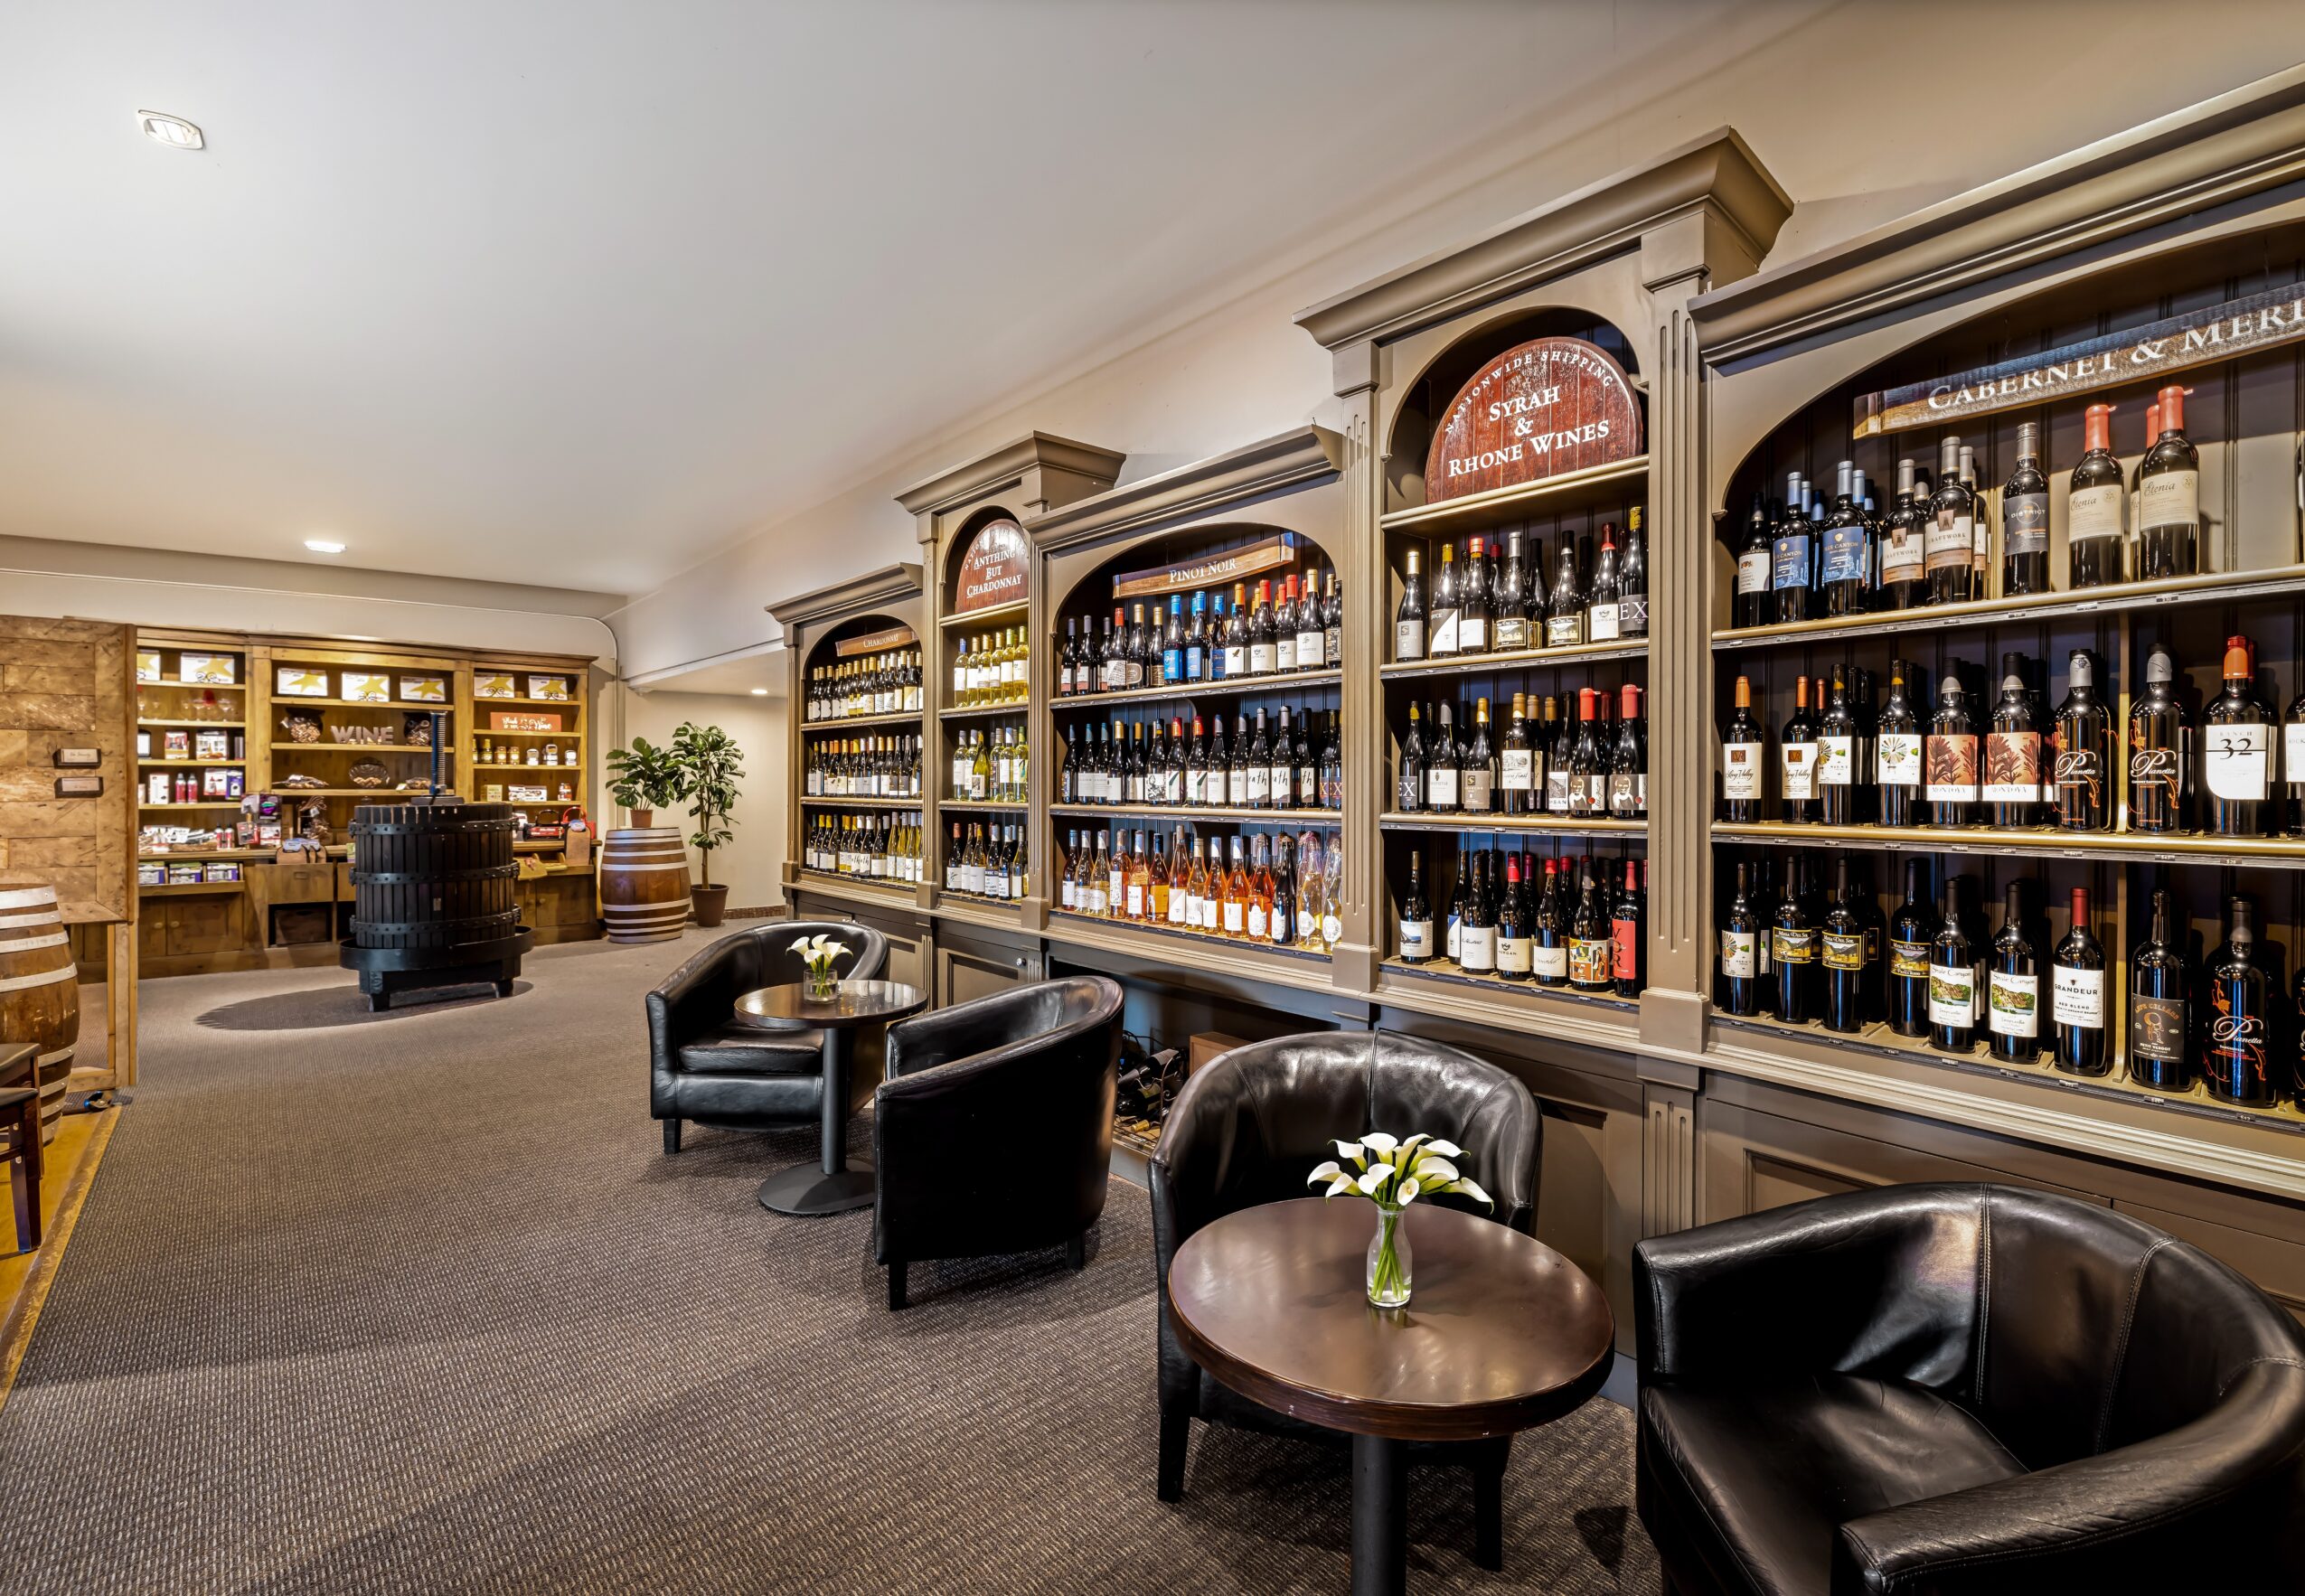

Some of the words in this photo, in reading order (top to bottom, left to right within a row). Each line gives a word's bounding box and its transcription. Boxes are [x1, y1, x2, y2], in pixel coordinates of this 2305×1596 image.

[1927, 349, 2119, 409] CABERNET
[2131, 336, 2169, 364] &
[1445, 353, 1532, 435] NATIONWIDE
[1541, 351, 1614, 387] SHIPPING
[1489, 385, 1560, 422] SYRAH
[1514, 418, 1534, 437] &
[1448, 444, 1523, 477] RHONE
[1530, 419, 1609, 455] WINES
[974, 549, 1016, 569] ANYTHING
[1169, 566, 1206, 583] PINOT
[1207, 558, 1237, 576] NOIR
[986, 566, 1002, 580] BUT
[966, 574, 1022, 598] CHARDONNAY
[1619, 601, 1649, 621] EX
[331, 726, 393, 745] WINE
[2220, 737, 2253, 760] 32
[2131, 749, 2178, 778] Pianetta
[2054, 983, 2098, 995] GRANDEUR
